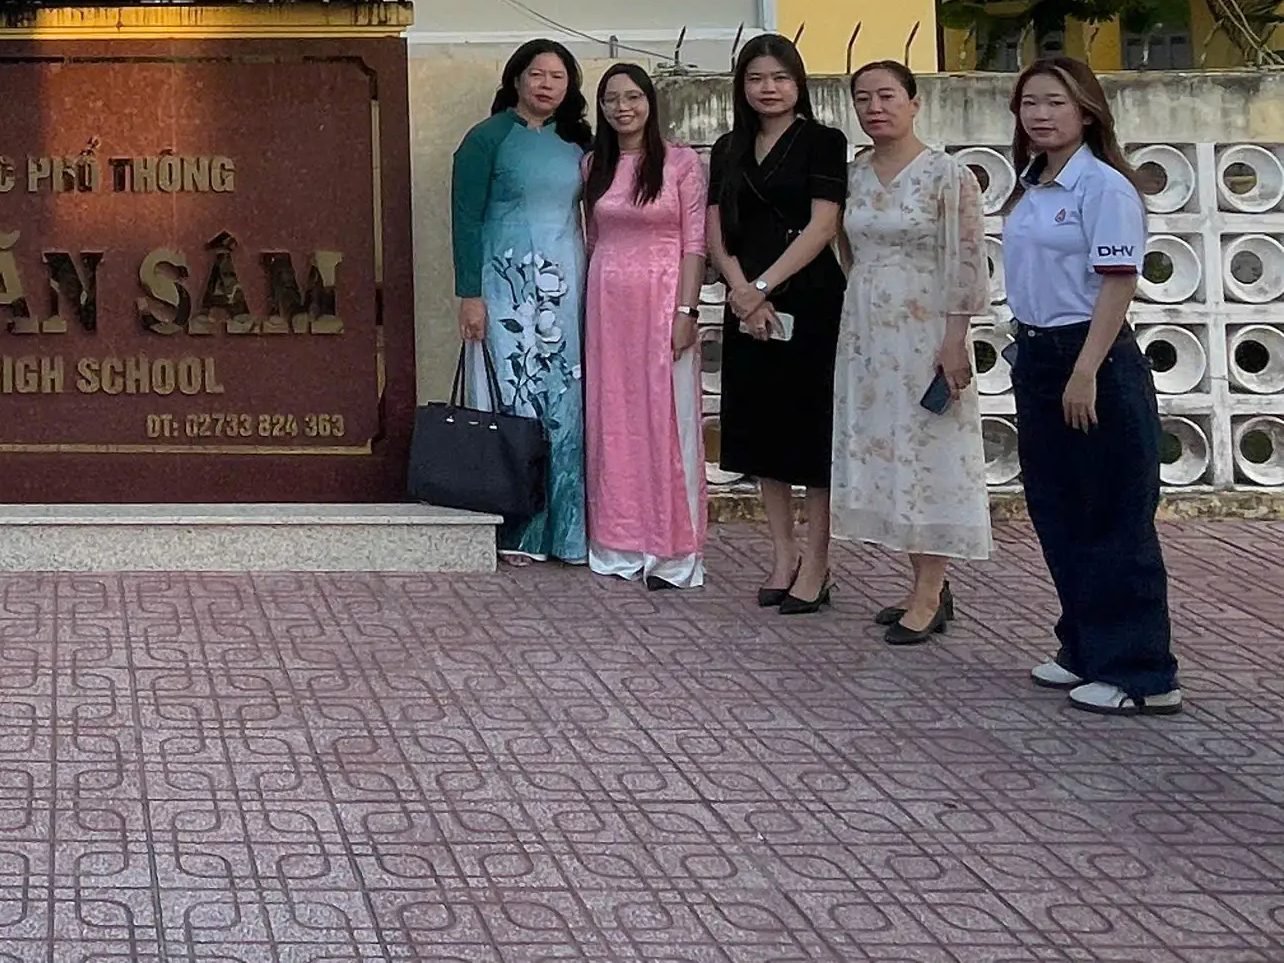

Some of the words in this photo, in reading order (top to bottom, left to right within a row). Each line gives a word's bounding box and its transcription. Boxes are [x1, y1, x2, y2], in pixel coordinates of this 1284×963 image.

[1097, 244, 1135, 257] DHV
[135, 229, 344, 335] SÂM
[76, 355, 225, 395] SCHOOL
[185, 413, 252, 437] 02733
[258, 413, 298, 437] 824
[304, 413, 345, 437] 363
